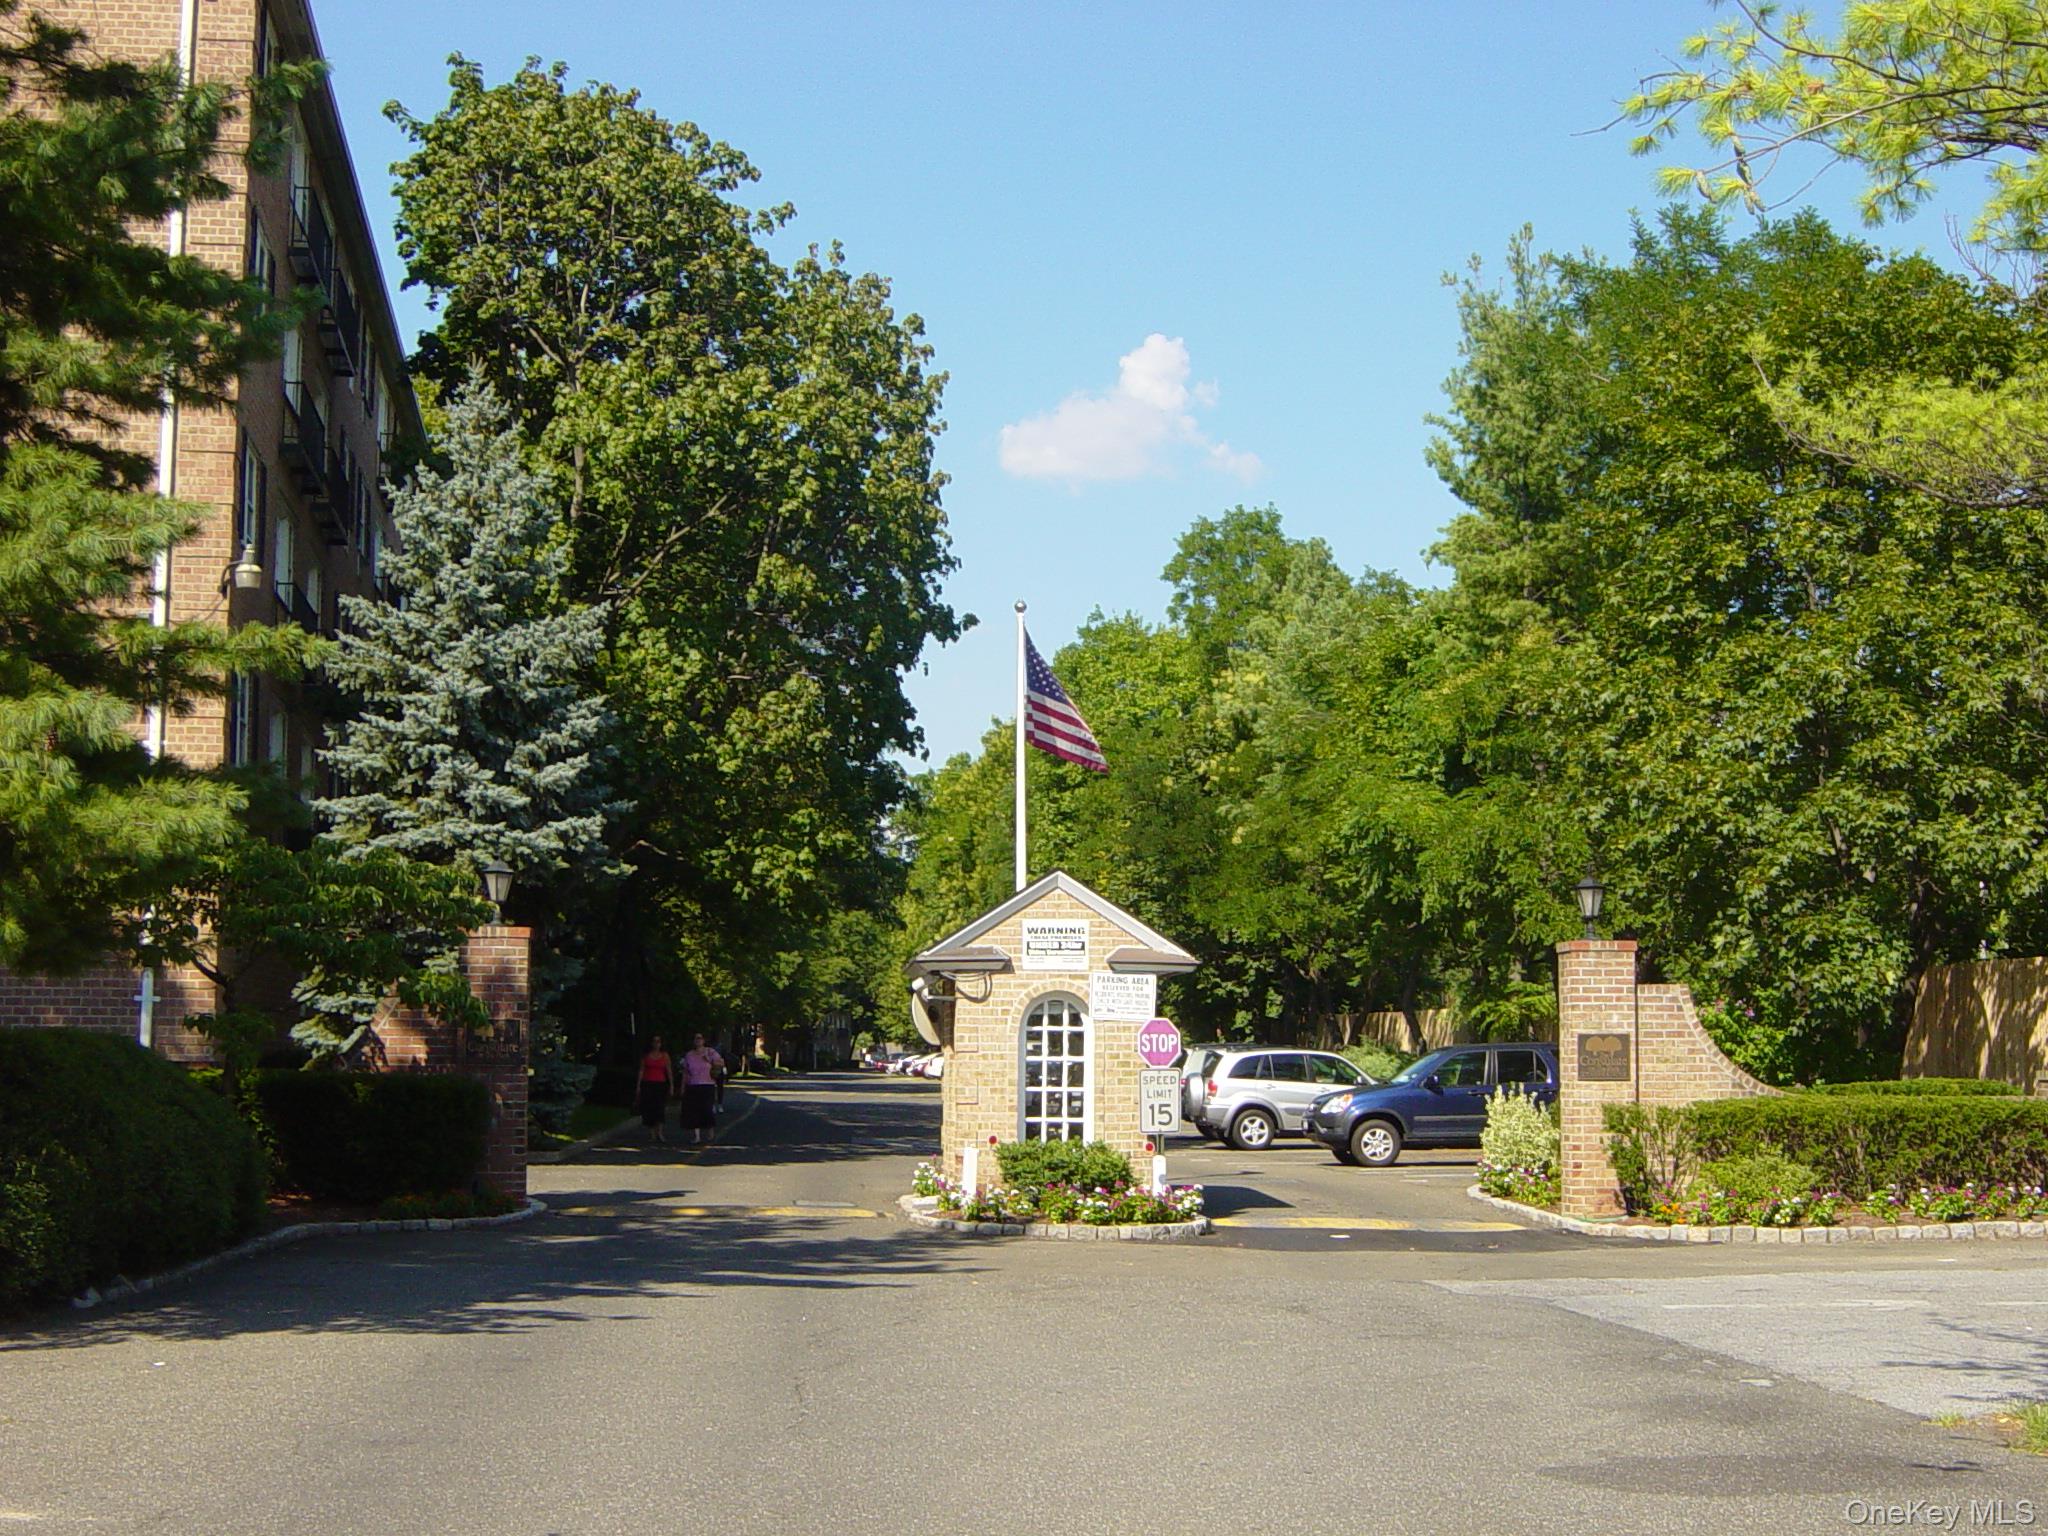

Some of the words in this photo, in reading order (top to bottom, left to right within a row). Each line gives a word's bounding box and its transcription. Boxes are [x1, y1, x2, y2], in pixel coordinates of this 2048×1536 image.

[1026, 926, 1086, 935] WARNING
[1096, 975, 1129, 984] PARKING
[1131, 976, 1149, 985] AREA
[1141, 1033, 1178, 1053] STOP
[1143, 1075, 1177, 1085] SPEED
[1146, 1089, 1172, 1099] LIMIT
[1149, 1103, 1173, 1126] 15
